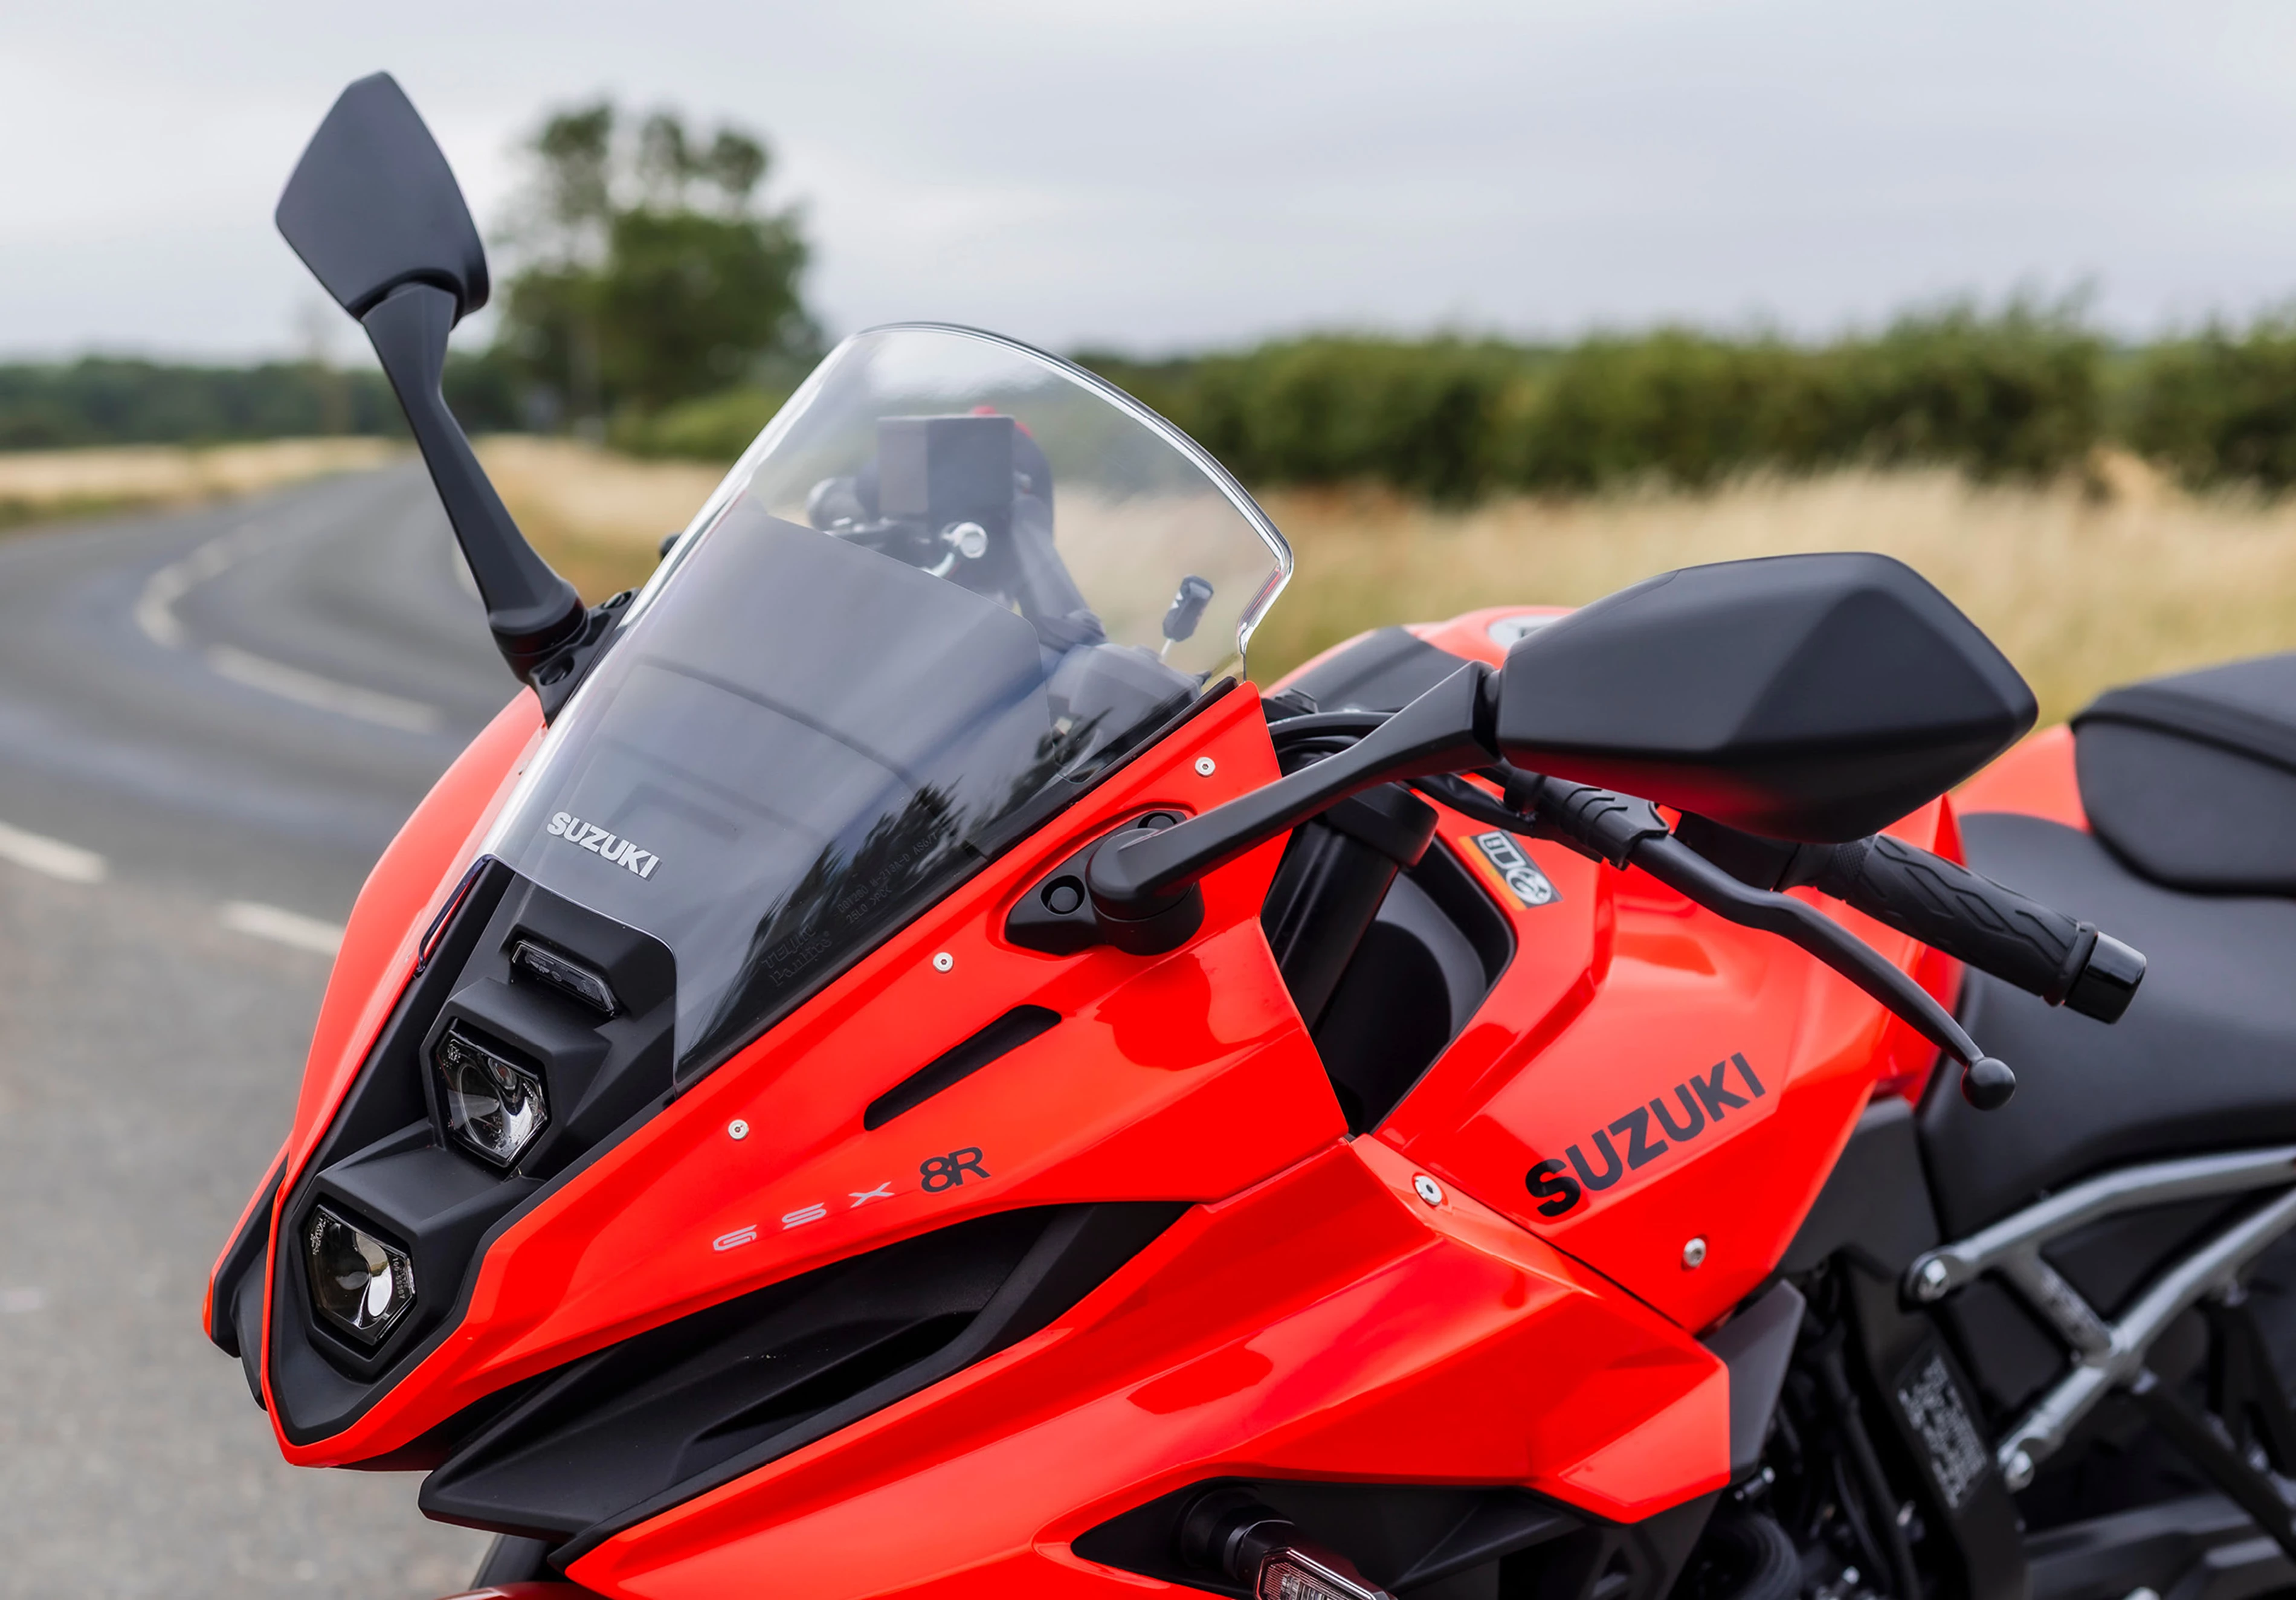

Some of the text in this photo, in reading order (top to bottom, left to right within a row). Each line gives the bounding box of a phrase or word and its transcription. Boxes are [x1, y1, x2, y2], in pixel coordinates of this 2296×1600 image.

[547, 811, 660, 879] SUZUKI
[1525, 1052, 1766, 1217] SUZUKI
[919, 1146, 992, 1193] 8R
